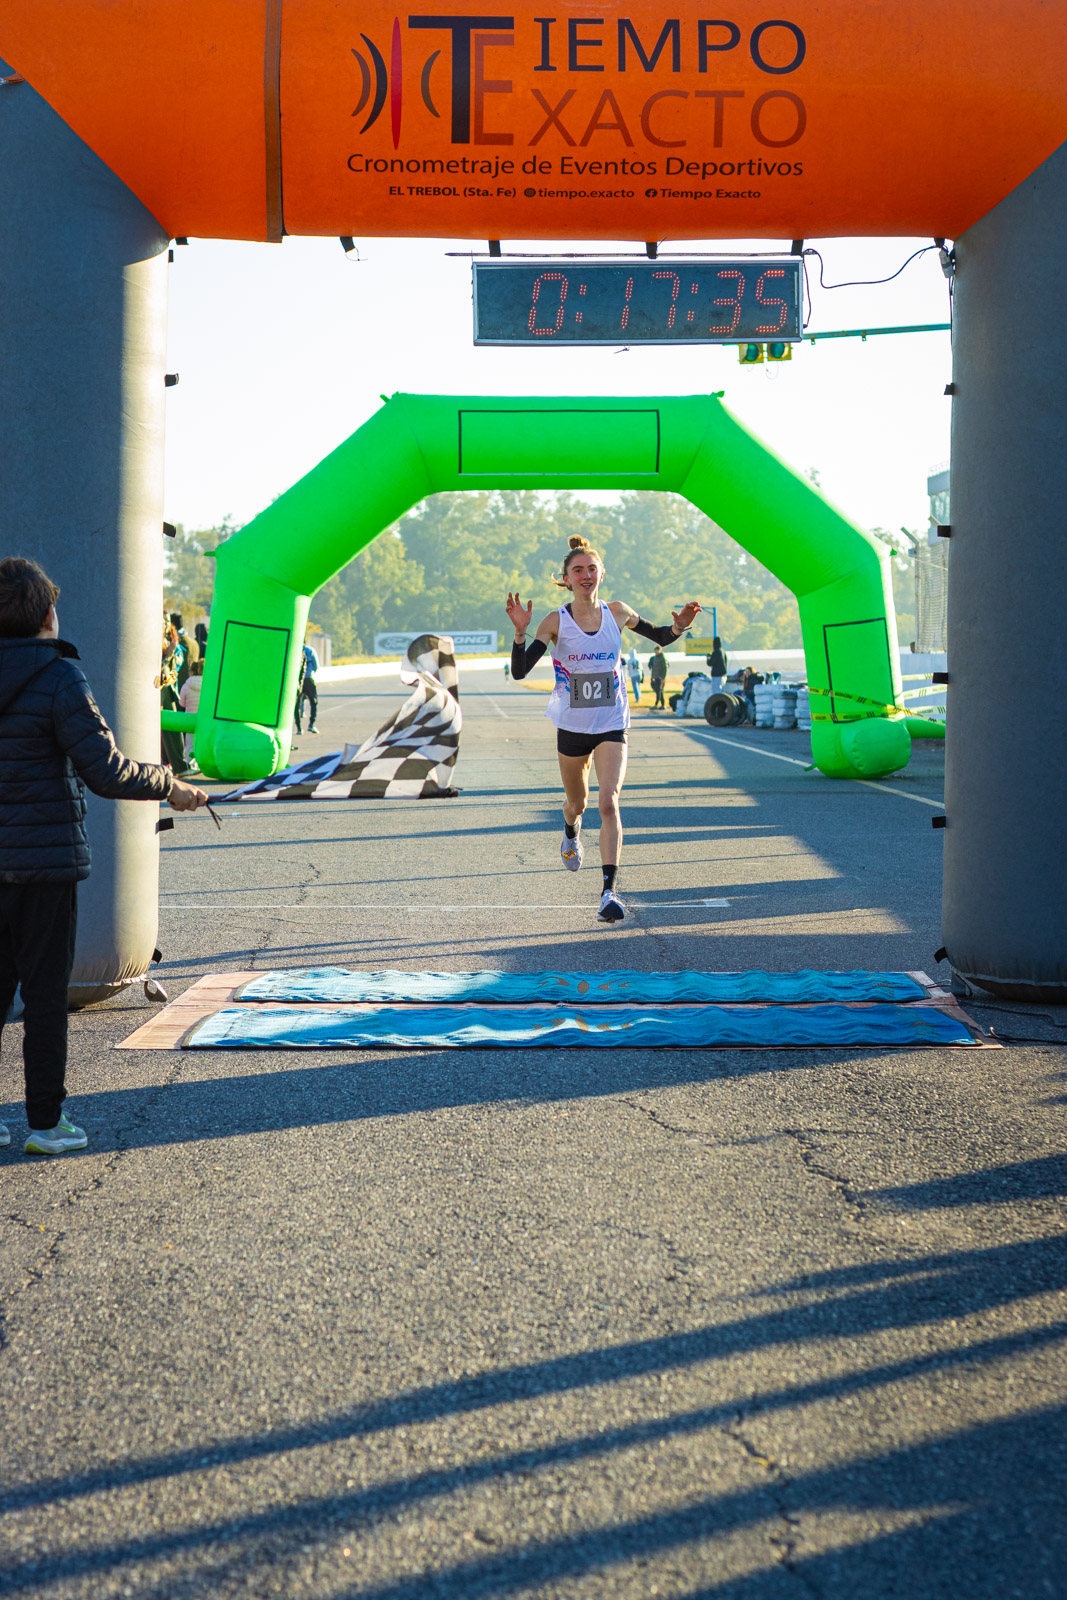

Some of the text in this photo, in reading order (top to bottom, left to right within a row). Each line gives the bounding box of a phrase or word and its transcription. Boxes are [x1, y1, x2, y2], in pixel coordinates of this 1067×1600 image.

[347, 153, 804, 180] Cronometraje de Eventos Deportivos
[389, 186, 761, 201] EL TREBOL (Sta. Fe) tiempo.exacto Tiempo Exacto
[528, 269, 787, 335] 0:17:35
[568, 652, 615, 661] RUNNEA
[582, 680, 602, 699] 02
